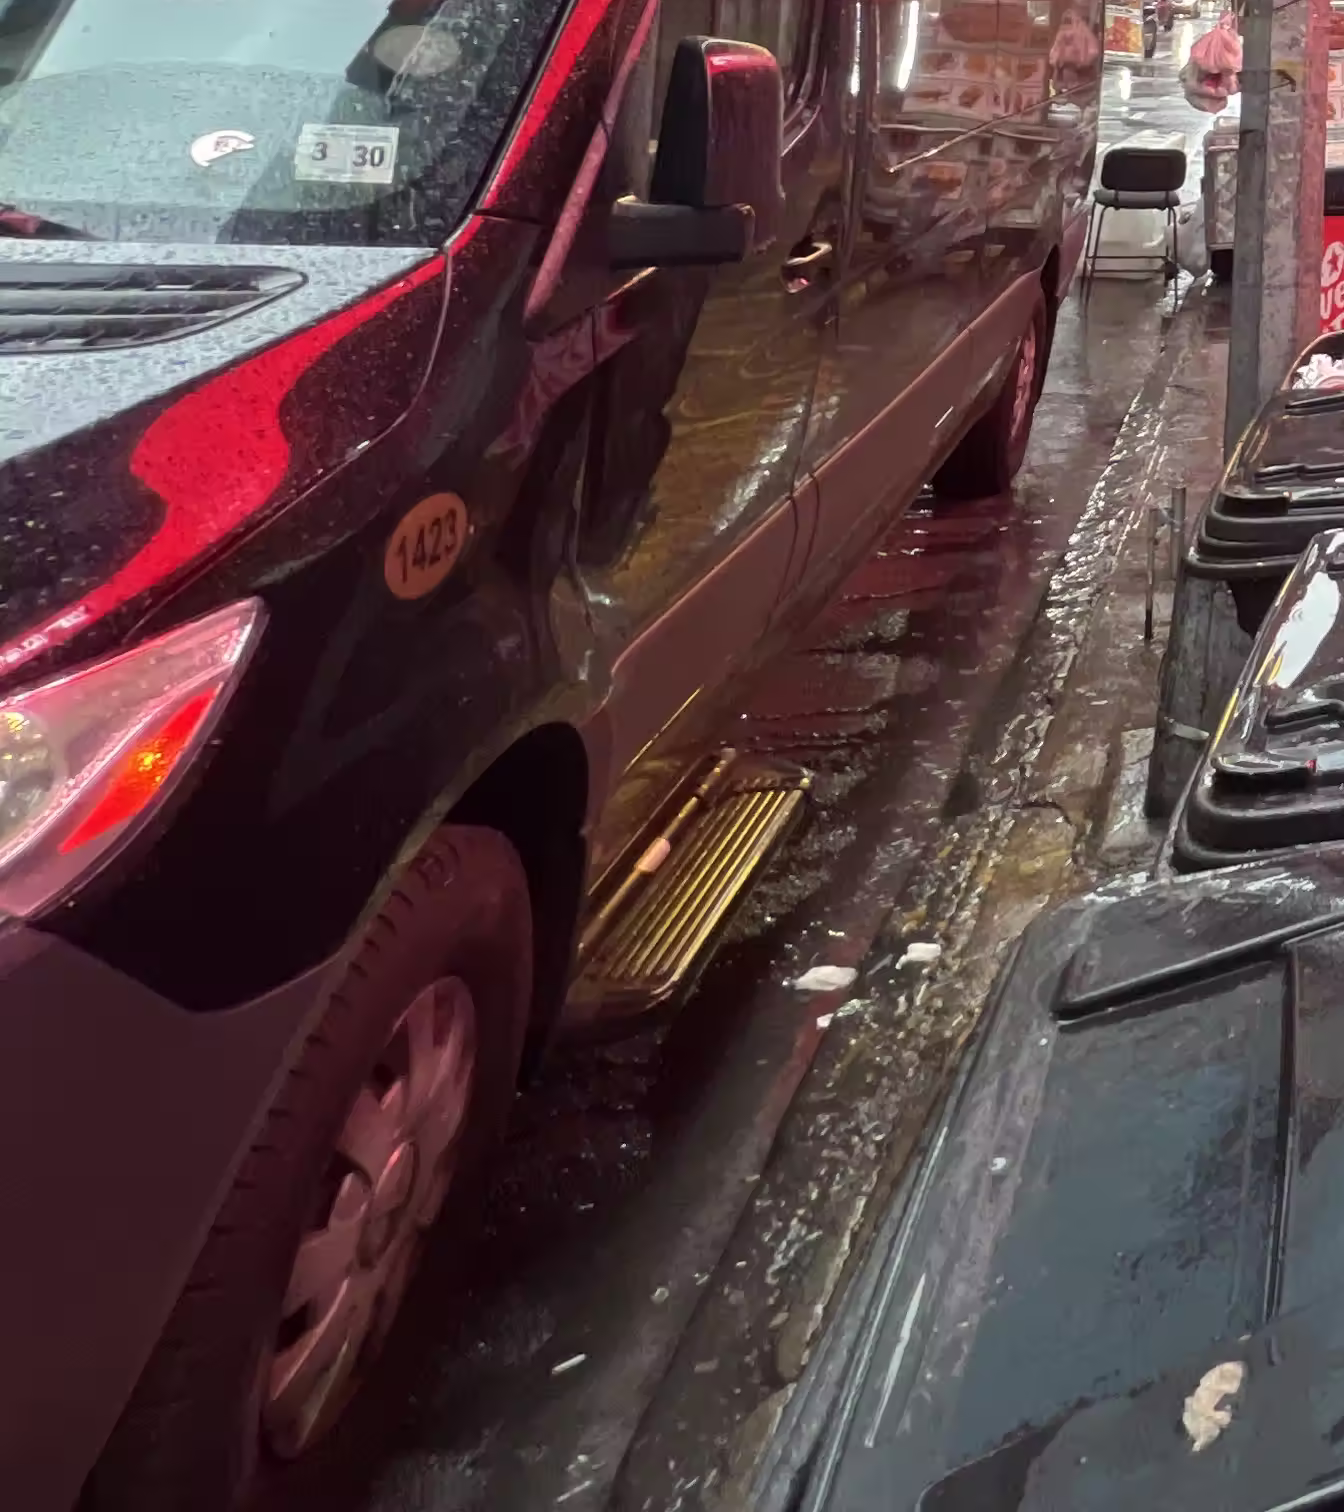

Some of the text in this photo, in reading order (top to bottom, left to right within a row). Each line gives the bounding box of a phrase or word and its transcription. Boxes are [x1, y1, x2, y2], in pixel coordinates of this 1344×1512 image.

[311, 142, 385, 168] 3 30
[395, 506, 457, 584] 1423
